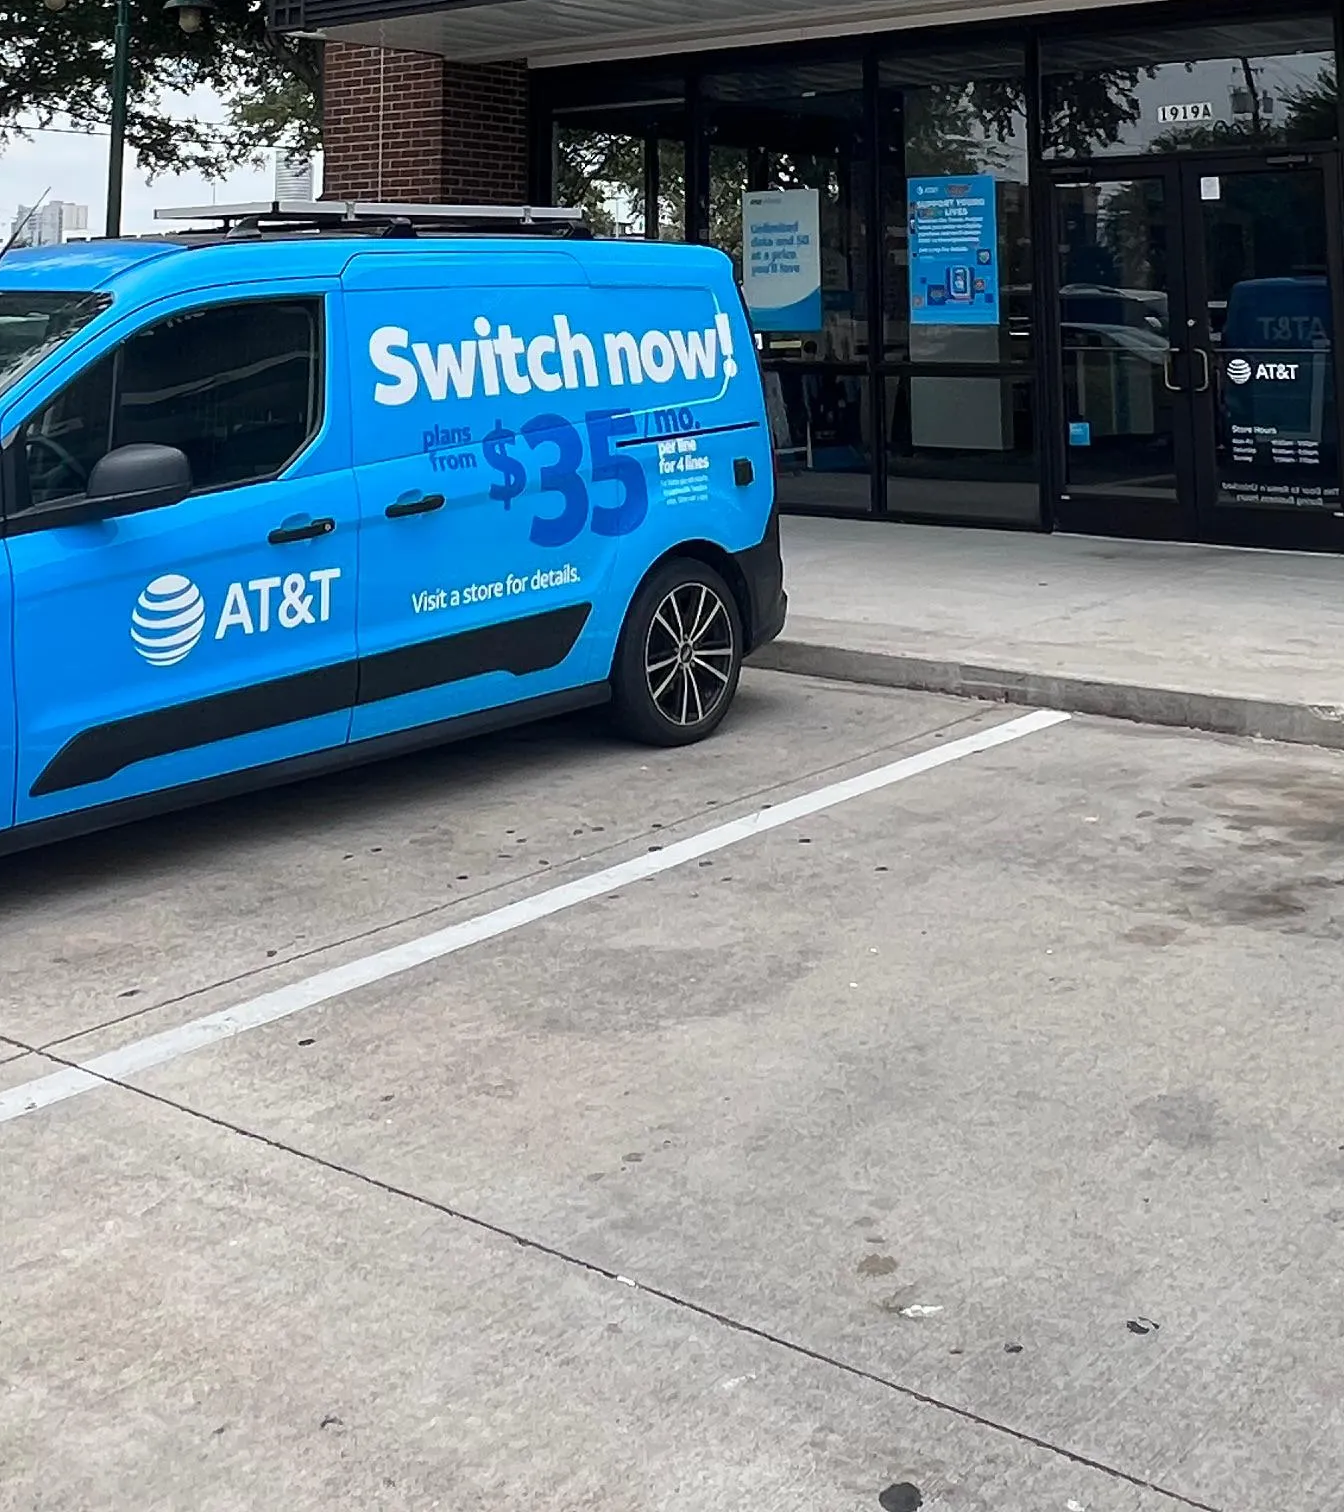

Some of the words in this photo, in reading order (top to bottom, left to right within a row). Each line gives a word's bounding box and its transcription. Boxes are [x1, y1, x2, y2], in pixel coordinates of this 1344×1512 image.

[1161, 104, 1211, 121] 1919A
[368, 313, 598, 406] Switch
[603, 312, 738, 386] now!
[1256, 364, 1299, 380] AT&T
[423, 422, 472, 454] plans
[429, 451, 478, 473] from
[659, 457, 676, 475] for
[676, 456, 685, 473] 4
[685, 454, 710, 471] lines
[411, 588, 448, 614] Visit
[450, 591, 460, 606] a
[462, 581, 504, 605] store
[505, 573, 529, 596] for
[530, 563, 581, 591] details.
[214, 567, 341, 640] AT&T
